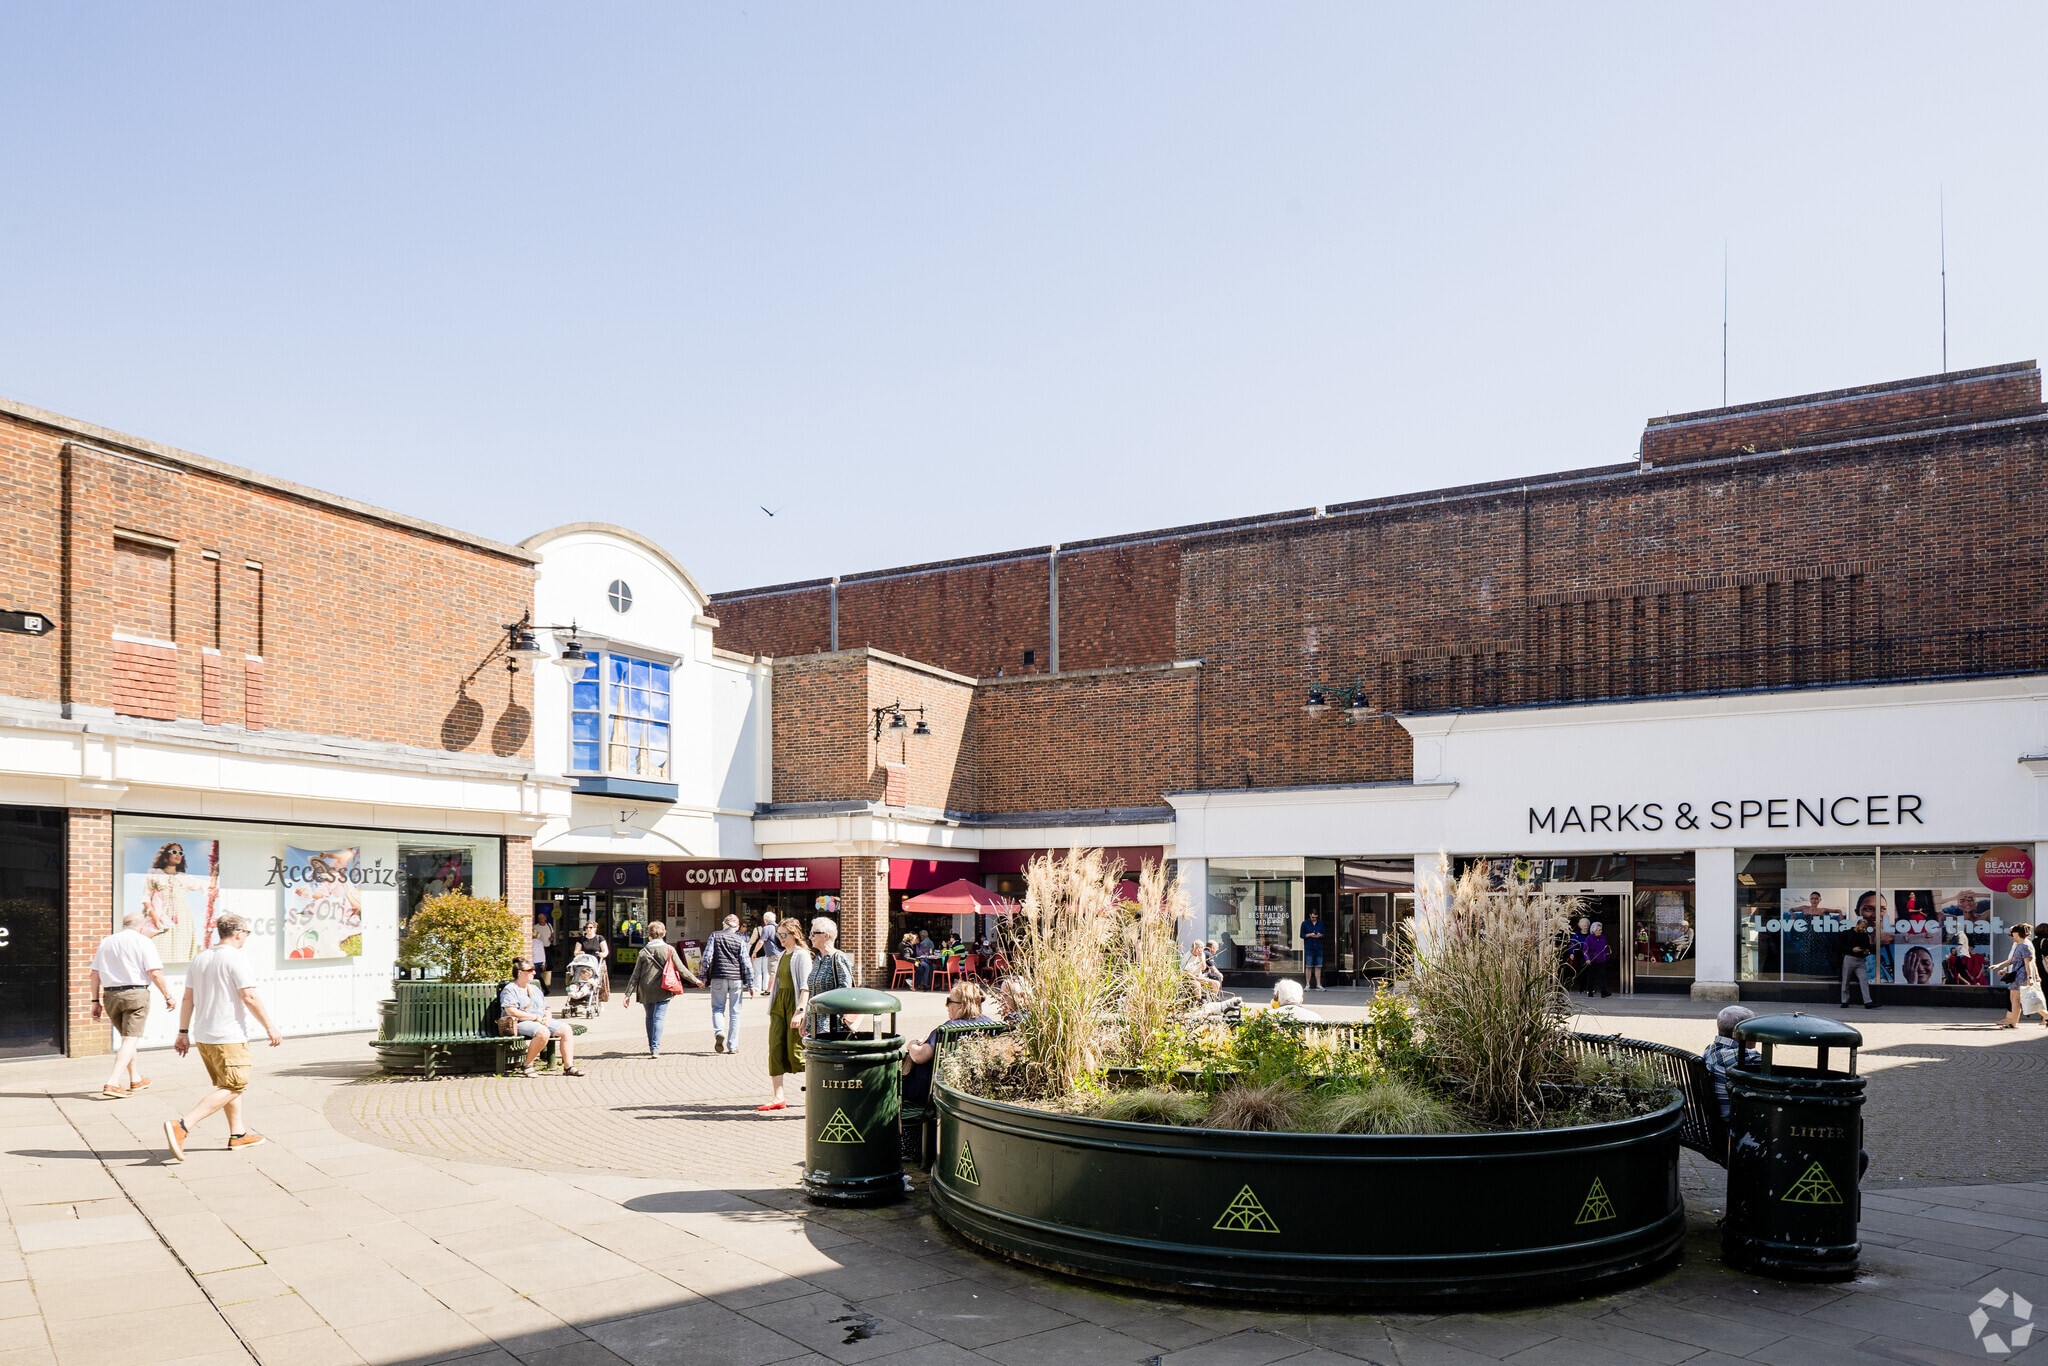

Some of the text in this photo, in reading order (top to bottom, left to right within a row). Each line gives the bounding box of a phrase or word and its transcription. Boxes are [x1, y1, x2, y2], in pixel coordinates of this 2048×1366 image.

[1528, 794, 1925, 834] MARKS & SPENCER
[265, 855, 407, 888] Accessorize
[1985, 861, 2026, 869] BEAUTY
[686, 866, 808, 885] COSTA COFFEE
[1754, 915, 1808, 933] Love
[1883, 915, 1940, 934] Love
[822, 1079, 863, 1089] LITTER
[1790, 1126, 1845, 1138] LITTER
